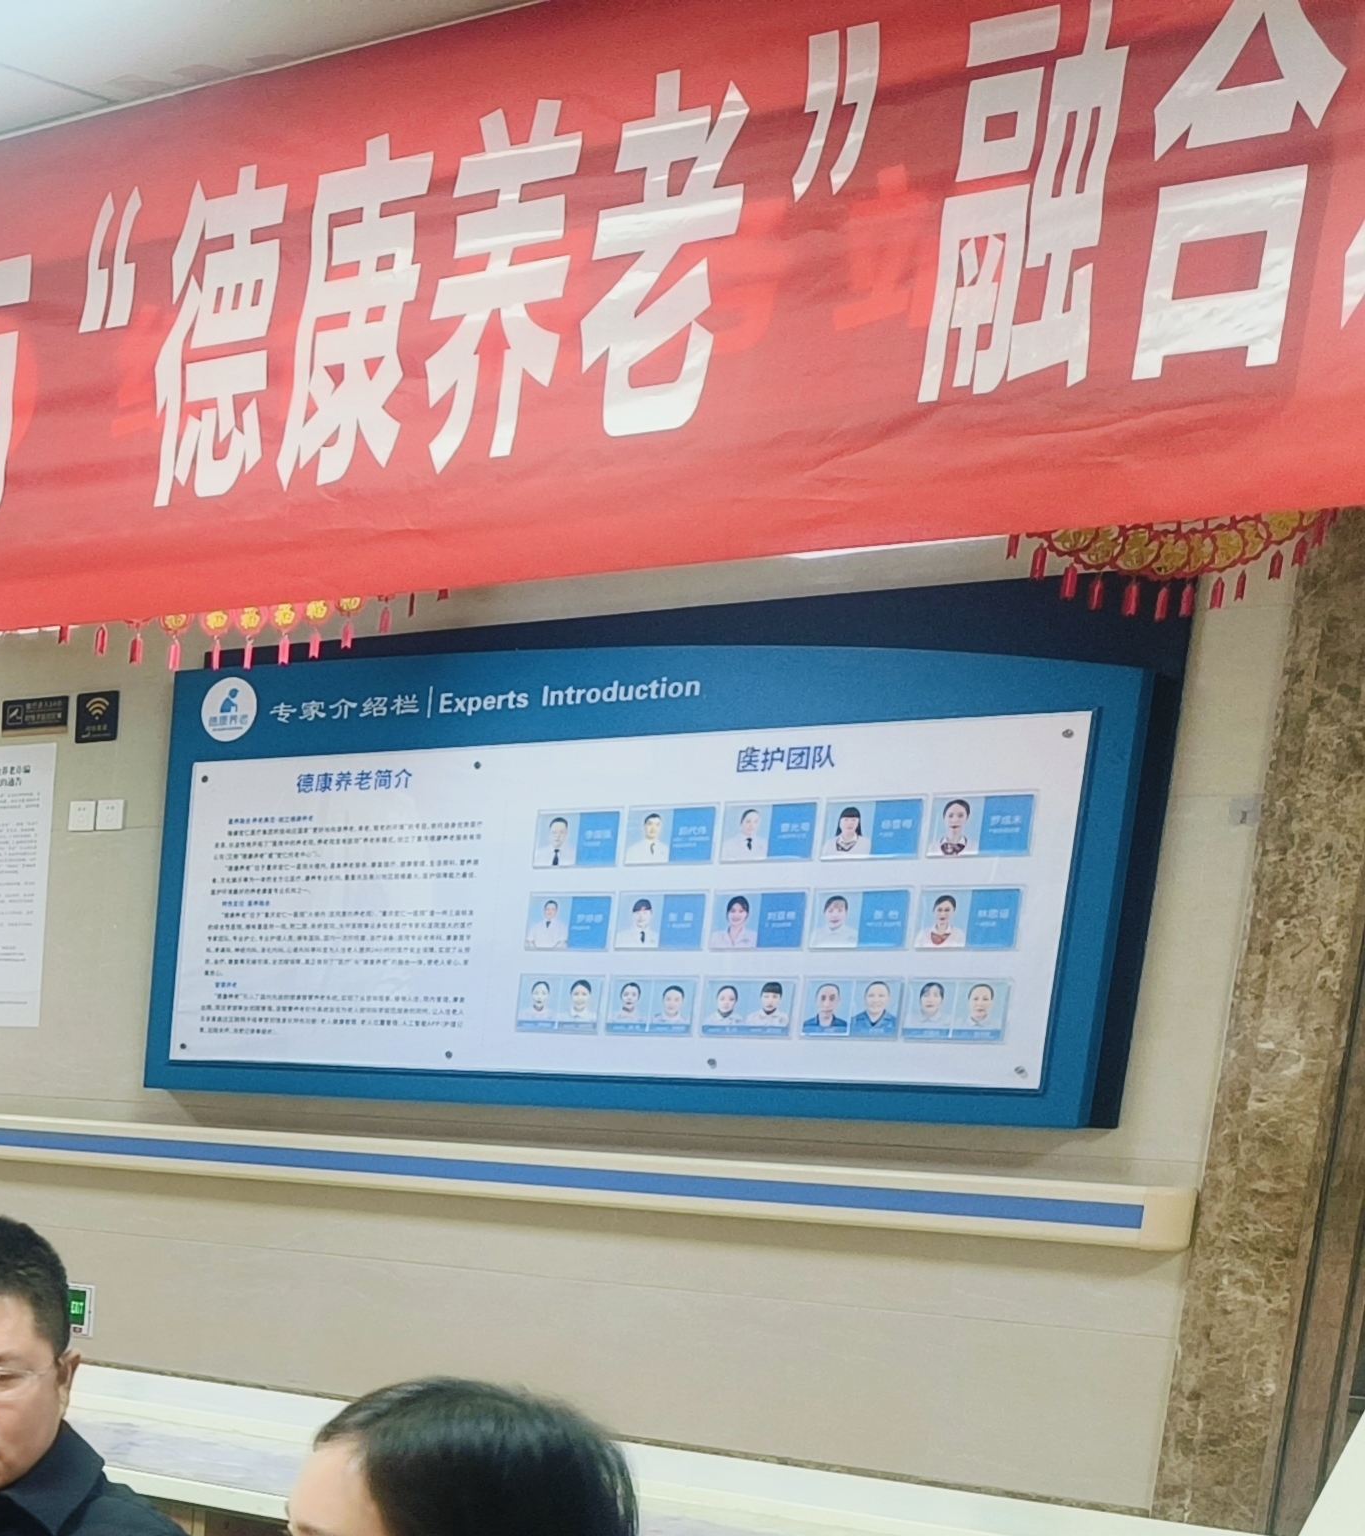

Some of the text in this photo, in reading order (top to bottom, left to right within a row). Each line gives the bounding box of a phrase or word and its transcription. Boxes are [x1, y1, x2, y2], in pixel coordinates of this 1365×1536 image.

[269, 677, 701, 724] 专家介绍栏 Experts Introduction
[736, 744, 836, 773] 医护团队
[296, 768, 413, 795] 德康养老简介
